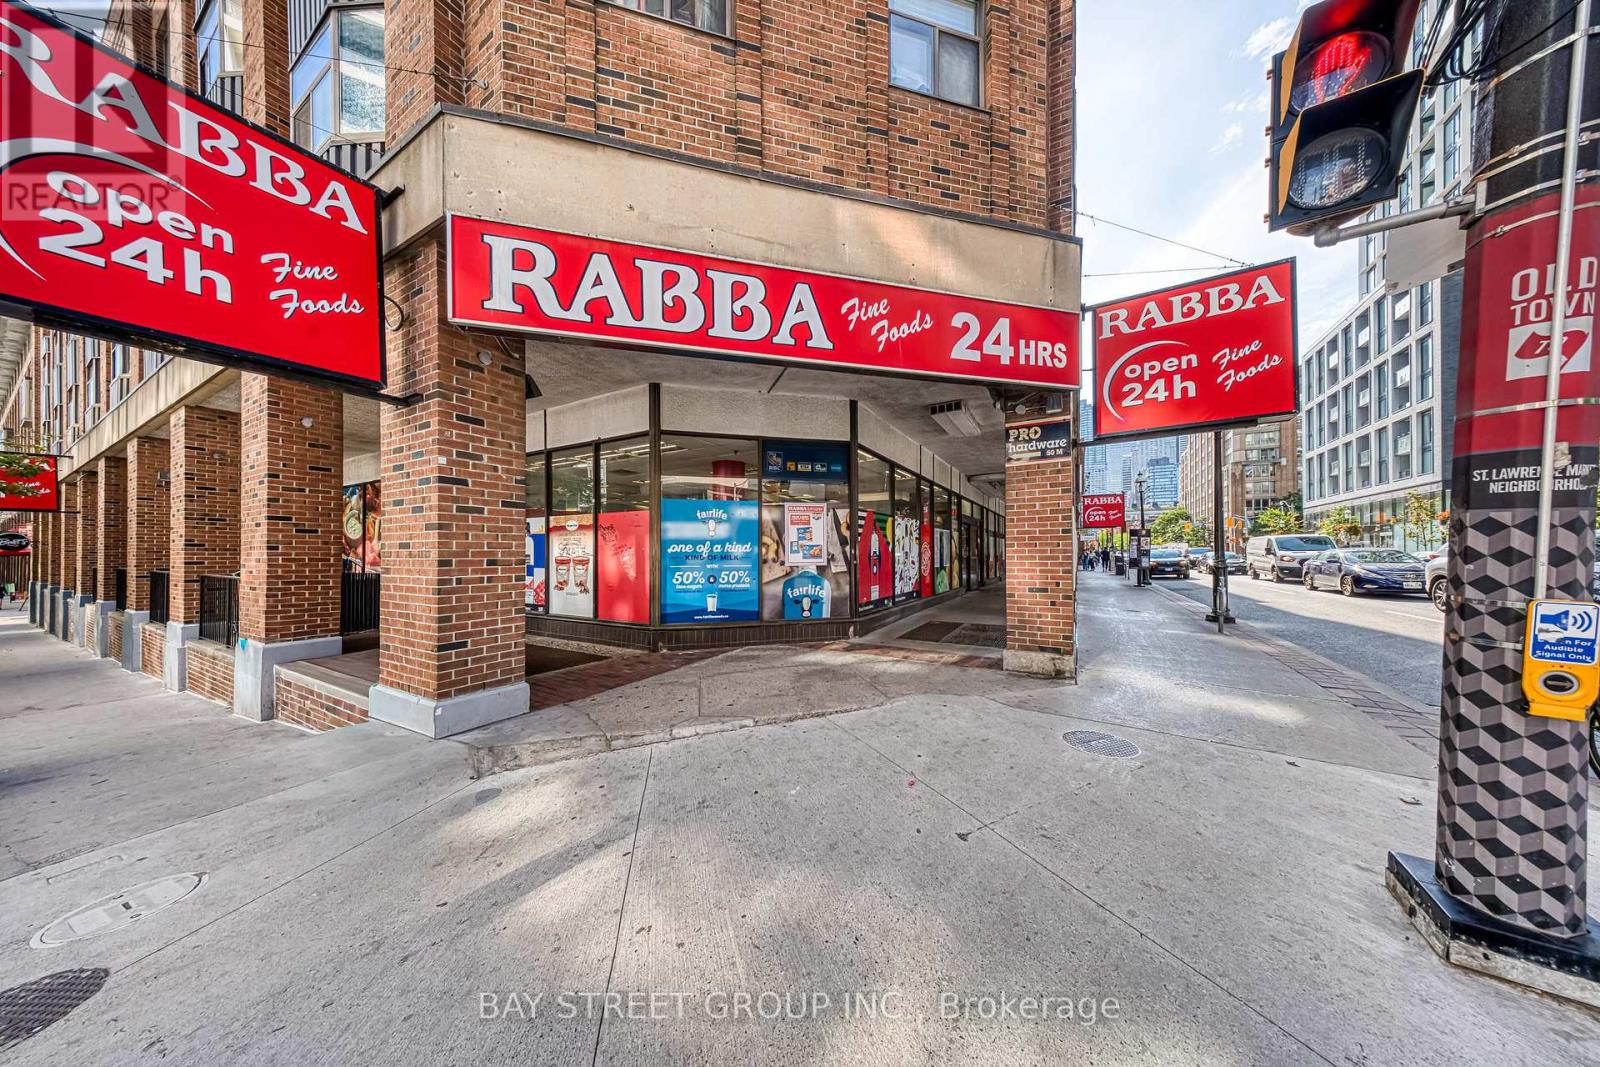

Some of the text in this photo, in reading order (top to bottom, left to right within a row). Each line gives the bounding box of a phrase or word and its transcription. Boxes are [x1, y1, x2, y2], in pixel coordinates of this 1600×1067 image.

[0, 17, 368, 235] RABBA
[46, 170, 235, 254] open
[38, 208, 233, 304] 24h
[260, 253, 339, 281] Fine
[269, 288, 366, 319] Foods
[481, 232, 835, 350] RABBA
[841, 297, 891, 331] Fine
[1098, 275, 1286, 339] RABBA
[870, 310, 934, 352] Foods
[950, 311, 1068, 369] 24 HRS
[1124, 353, 1198, 381] open
[1212, 340, 1263, 370] Fine
[1217, 354, 1283, 391] Foods
[1121, 374, 1197, 408] 24h
[1006, 438, 1067, 453] hardware
[1008, 426, 1041, 441] PRO
[1472, 469, 1490, 481] ST.
[1491, 465, 1563, 480] LAWREE
[696, 509, 728, 520] fairlife
[1084, 496, 1122, 505] RABBA
[667, 541, 752, 557] one of a kind
[672, 571, 705, 584] 50%
[719, 570, 750, 583] 50%
[787, 583, 825, 598] fairlife
[1534, 650, 1592, 662] Signal Only
[1543, 644, 1584, 653] Audible
